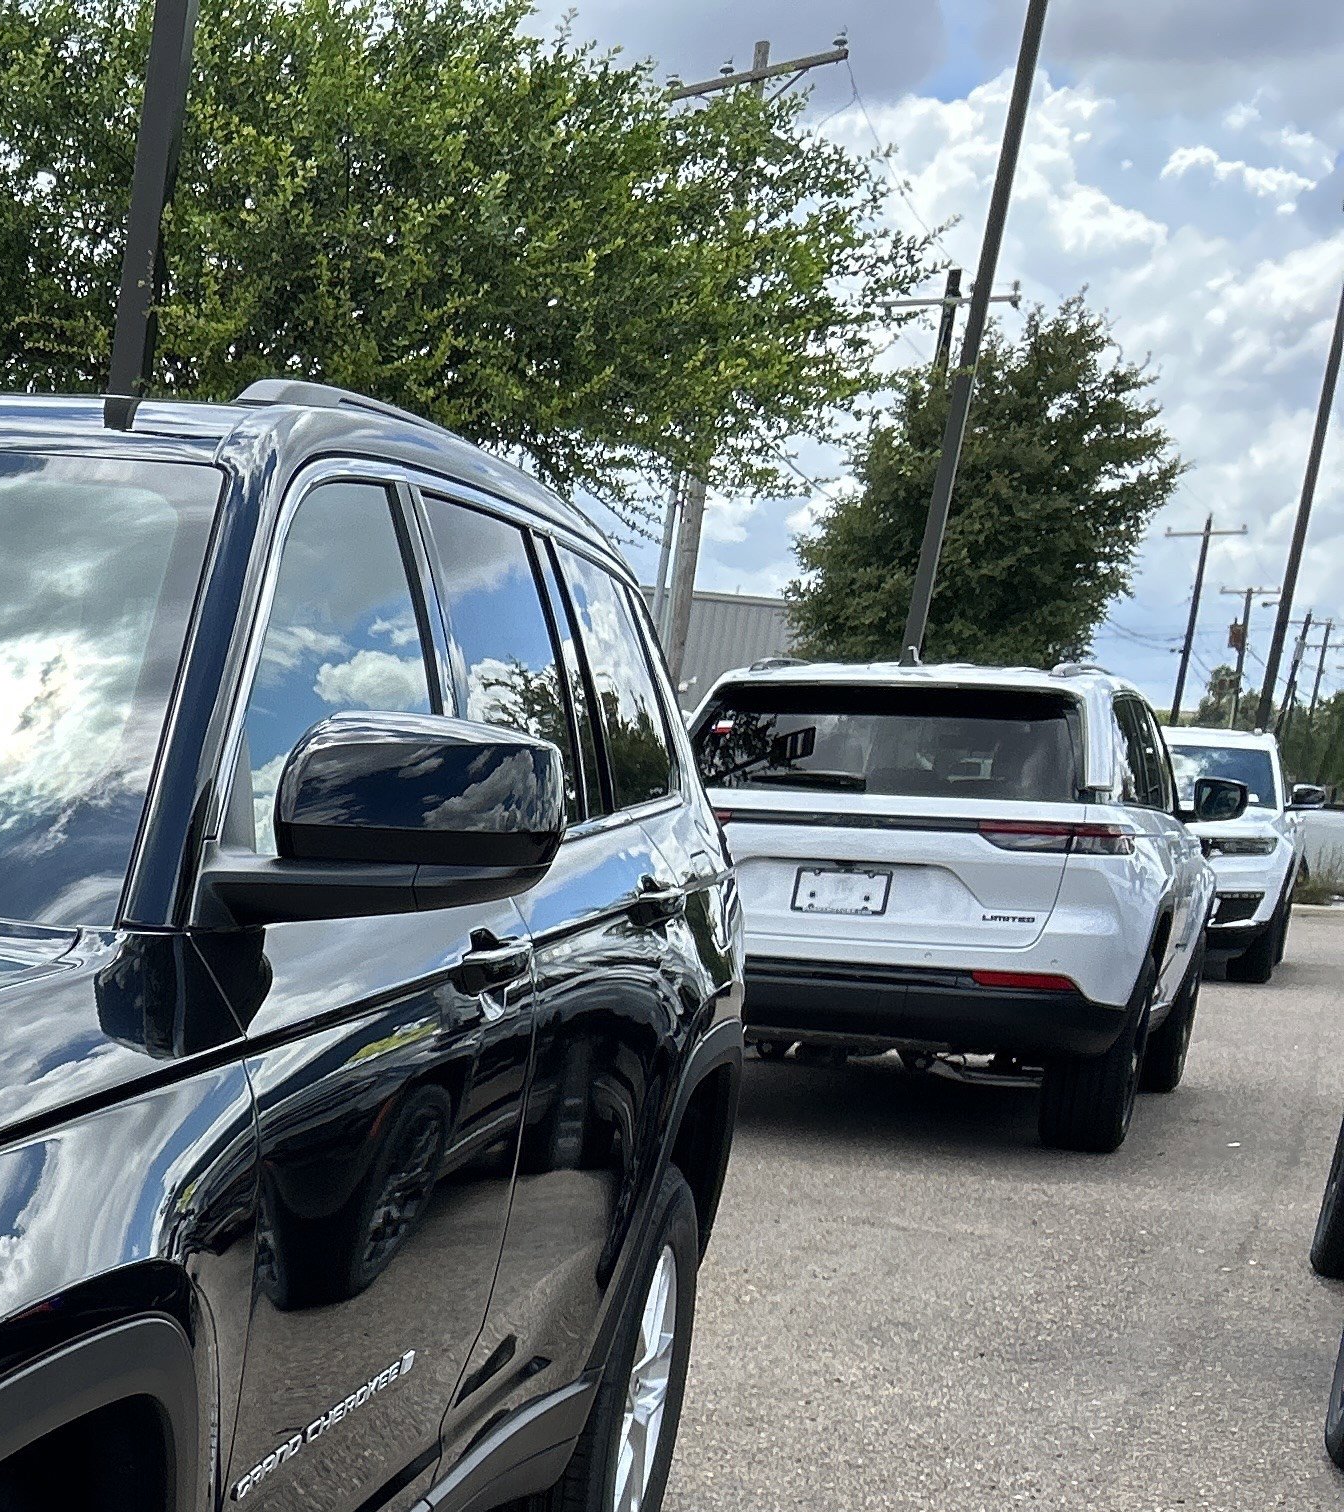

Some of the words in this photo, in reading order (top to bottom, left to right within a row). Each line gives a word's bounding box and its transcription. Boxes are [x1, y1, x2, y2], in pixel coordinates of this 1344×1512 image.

[982, 914, 1036, 924] LIMITED
[232, 1434, 303, 1501] GRAND
[302, 1361, 402, 1444] CHEROKEE
